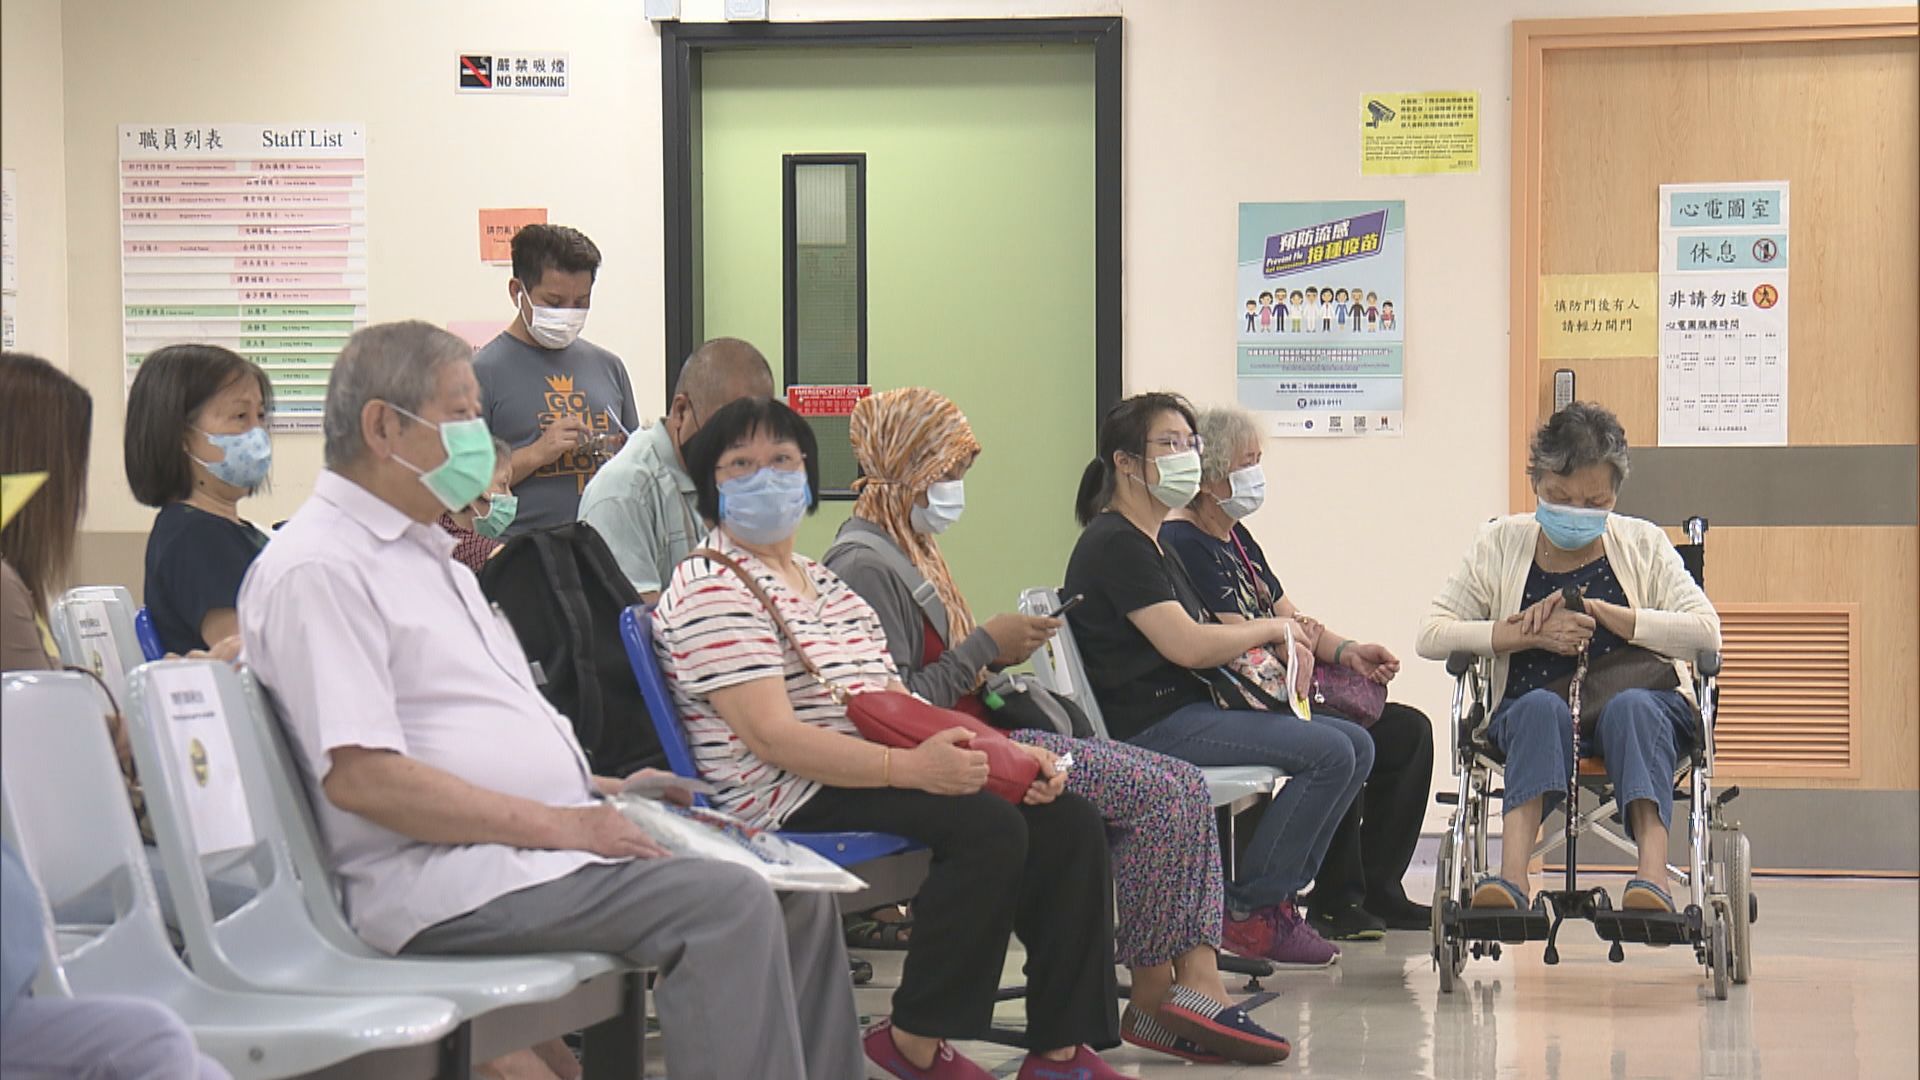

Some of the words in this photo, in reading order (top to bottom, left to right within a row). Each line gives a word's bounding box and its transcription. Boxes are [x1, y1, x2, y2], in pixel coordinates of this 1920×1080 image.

[497, 58, 565, 73] 嚴禁吸煙
[497, 76, 512, 87] NO
[515, 76, 565, 87] SMOKING
[138, 128, 223, 151] 職員列表
[262, 130, 306, 147] Staff
[310, 129, 343, 147] List
[1679, 198, 1769, 219] 心電圖室
[1279, 220, 1351, 253] 預防流感
[1307, 232, 1379, 265] 接種疫苗
[1690, 240, 1737, 264] 休息
[1266, 253, 1293, 268] Prevent
[1293, 251, 1304, 262] Flu
[1668, 290, 1750, 309] 非請勿進
[795, 388, 832, 396] EMERGENCY
[833, 388, 846, 396] EXIT
[847, 388, 865, 396] ONLY
[548, 393, 586, 411] GO
